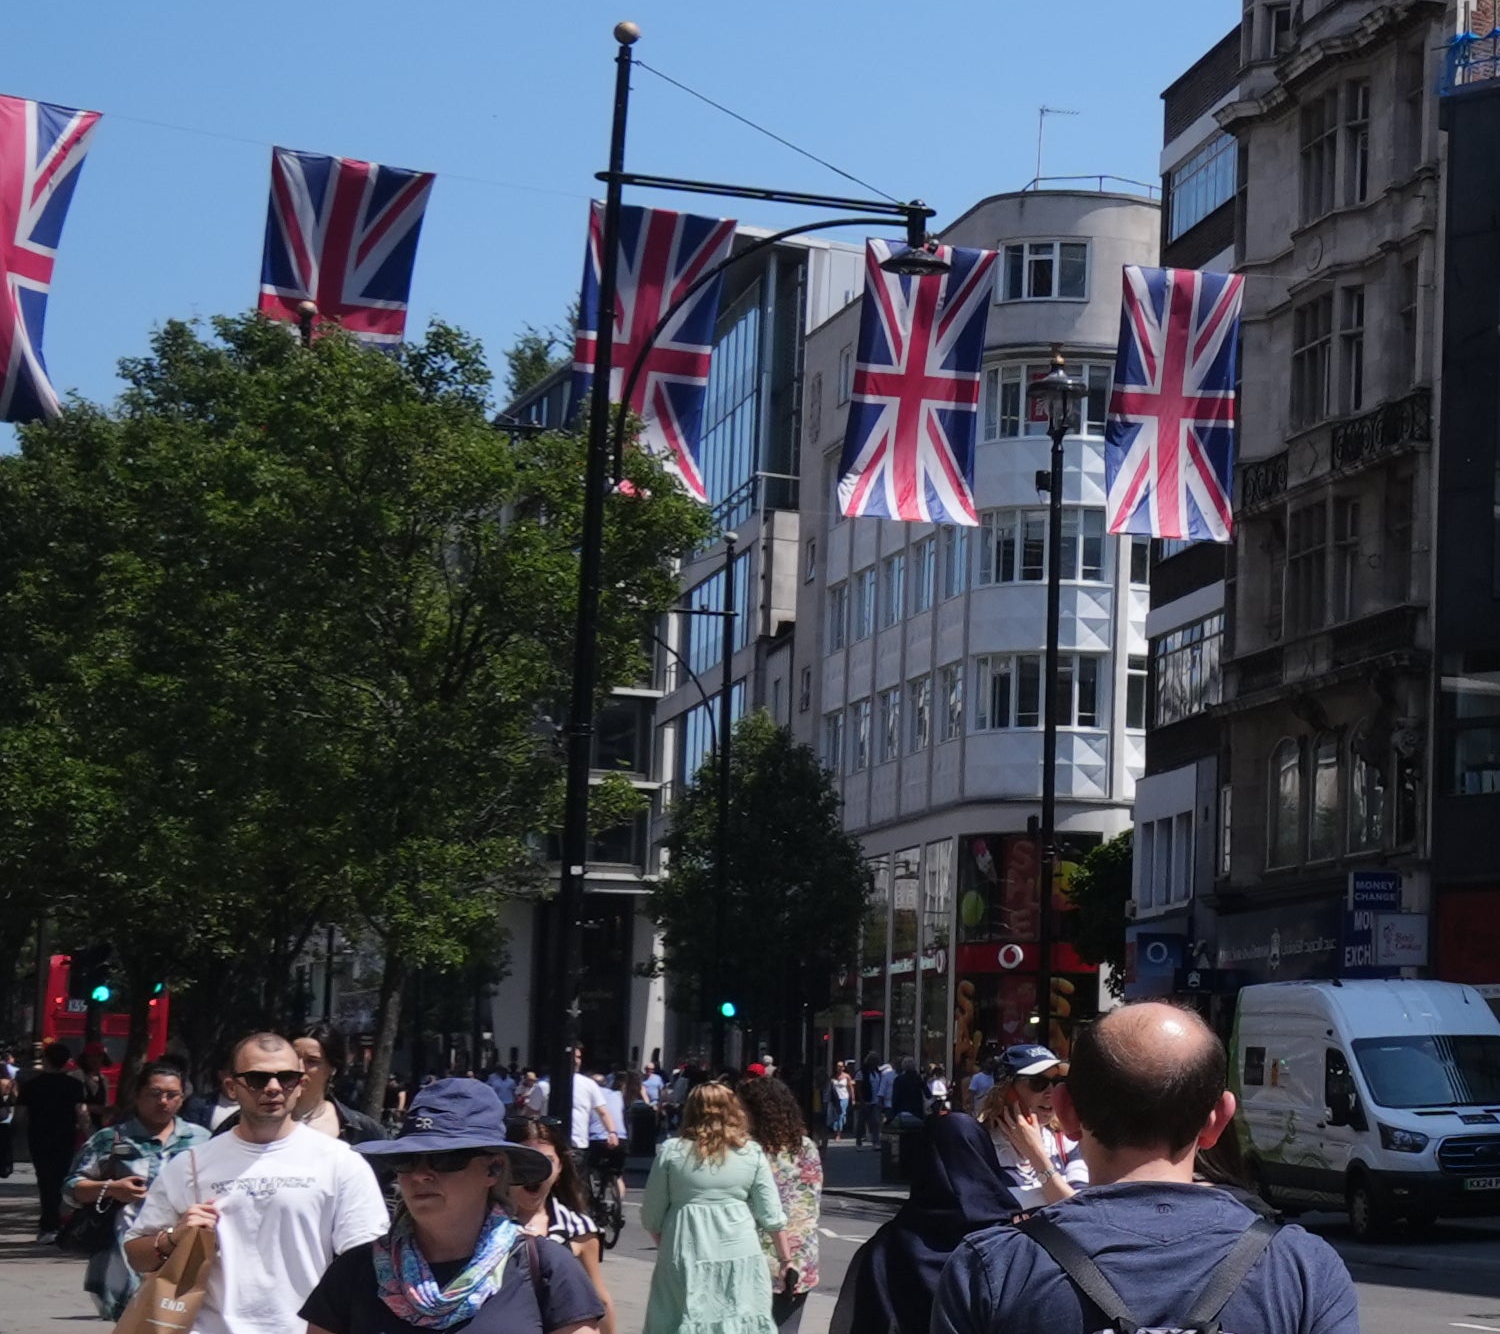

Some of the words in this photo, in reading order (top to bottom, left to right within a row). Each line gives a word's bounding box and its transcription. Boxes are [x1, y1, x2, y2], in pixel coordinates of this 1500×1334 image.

[1355, 880, 1395, 890] MONEY
[1354, 892, 1397, 902] CHANGE
[160, 1297, 187, 1314] END.
